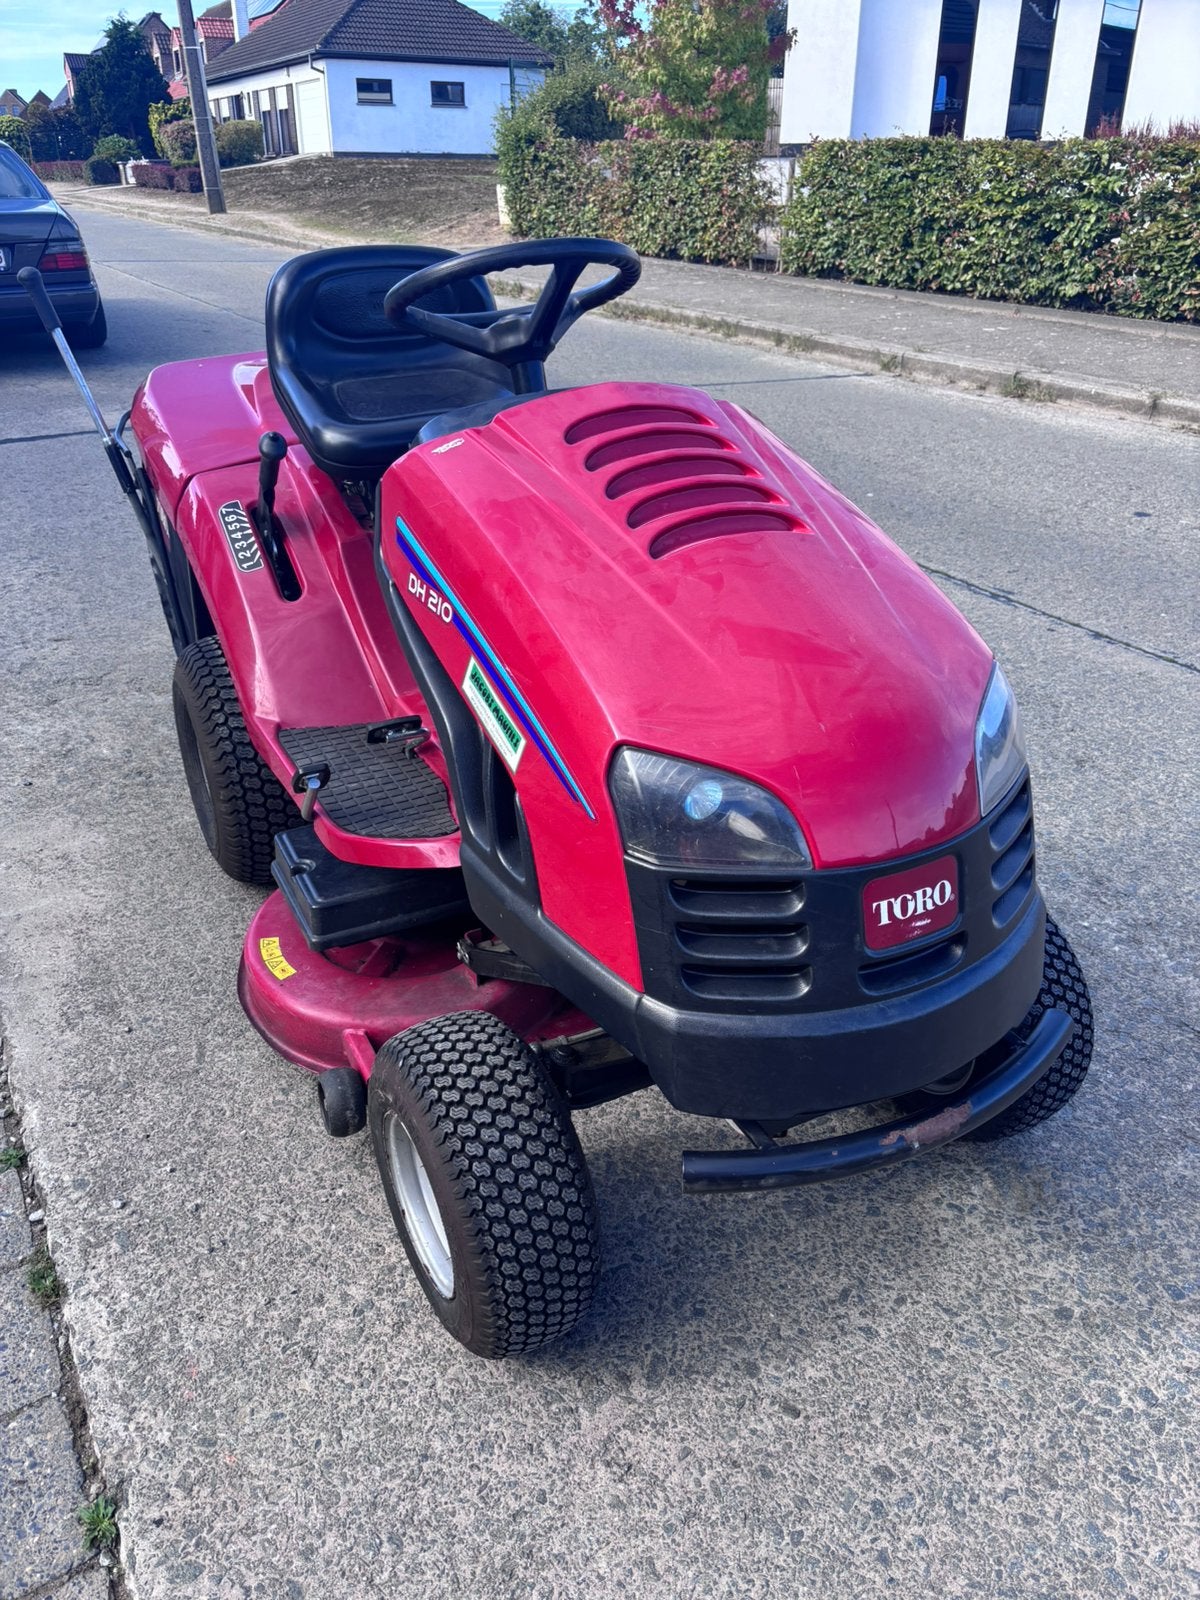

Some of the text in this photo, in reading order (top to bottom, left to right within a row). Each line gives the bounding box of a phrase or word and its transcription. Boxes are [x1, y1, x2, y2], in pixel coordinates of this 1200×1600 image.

[408, 572, 453, 623] DH 210
[872, 880, 952, 927] TORO
